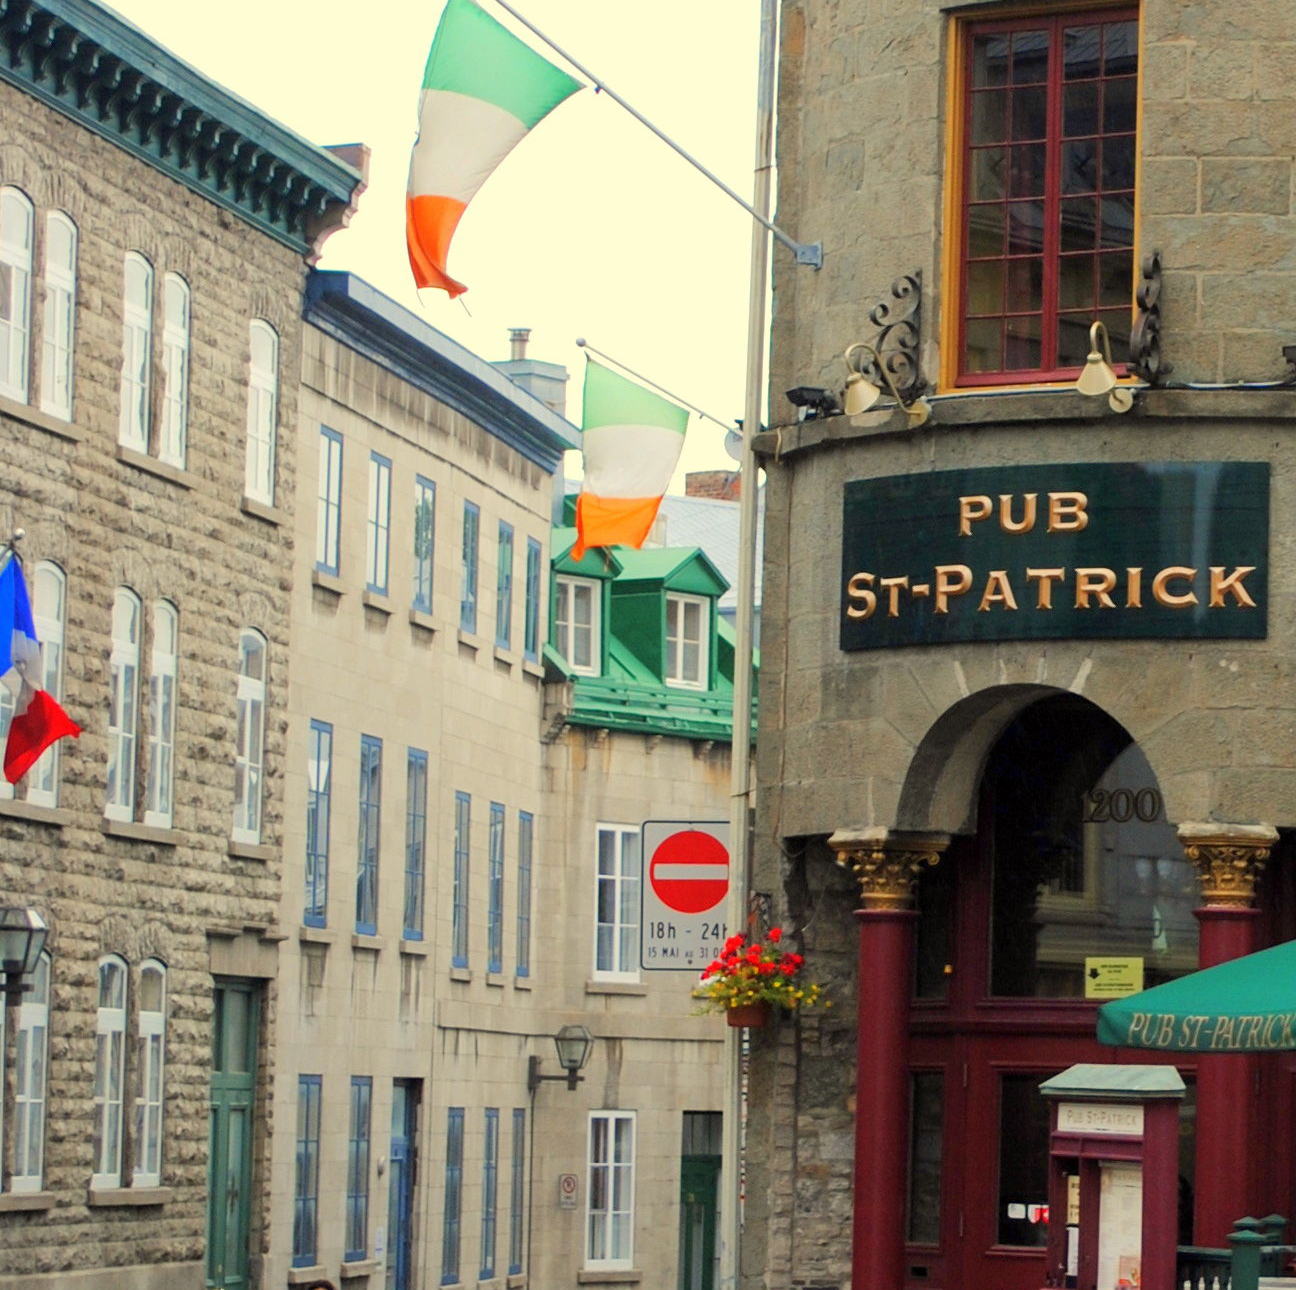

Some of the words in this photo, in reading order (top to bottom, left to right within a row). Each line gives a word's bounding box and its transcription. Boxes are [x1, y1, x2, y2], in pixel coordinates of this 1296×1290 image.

[957, 491, 1089, 537] PUB
[846, 564, 1257, 621] ST-PATRICK
[1081, 787, 1162, 823] 1200
[650, 921, 676, 939] 18h
[648, 946, 657, 958] 15
[662, 947, 679, 957] MAI
[700, 946, 708, 958] 31
[1128, 1012, 1174, 1047] PUB
